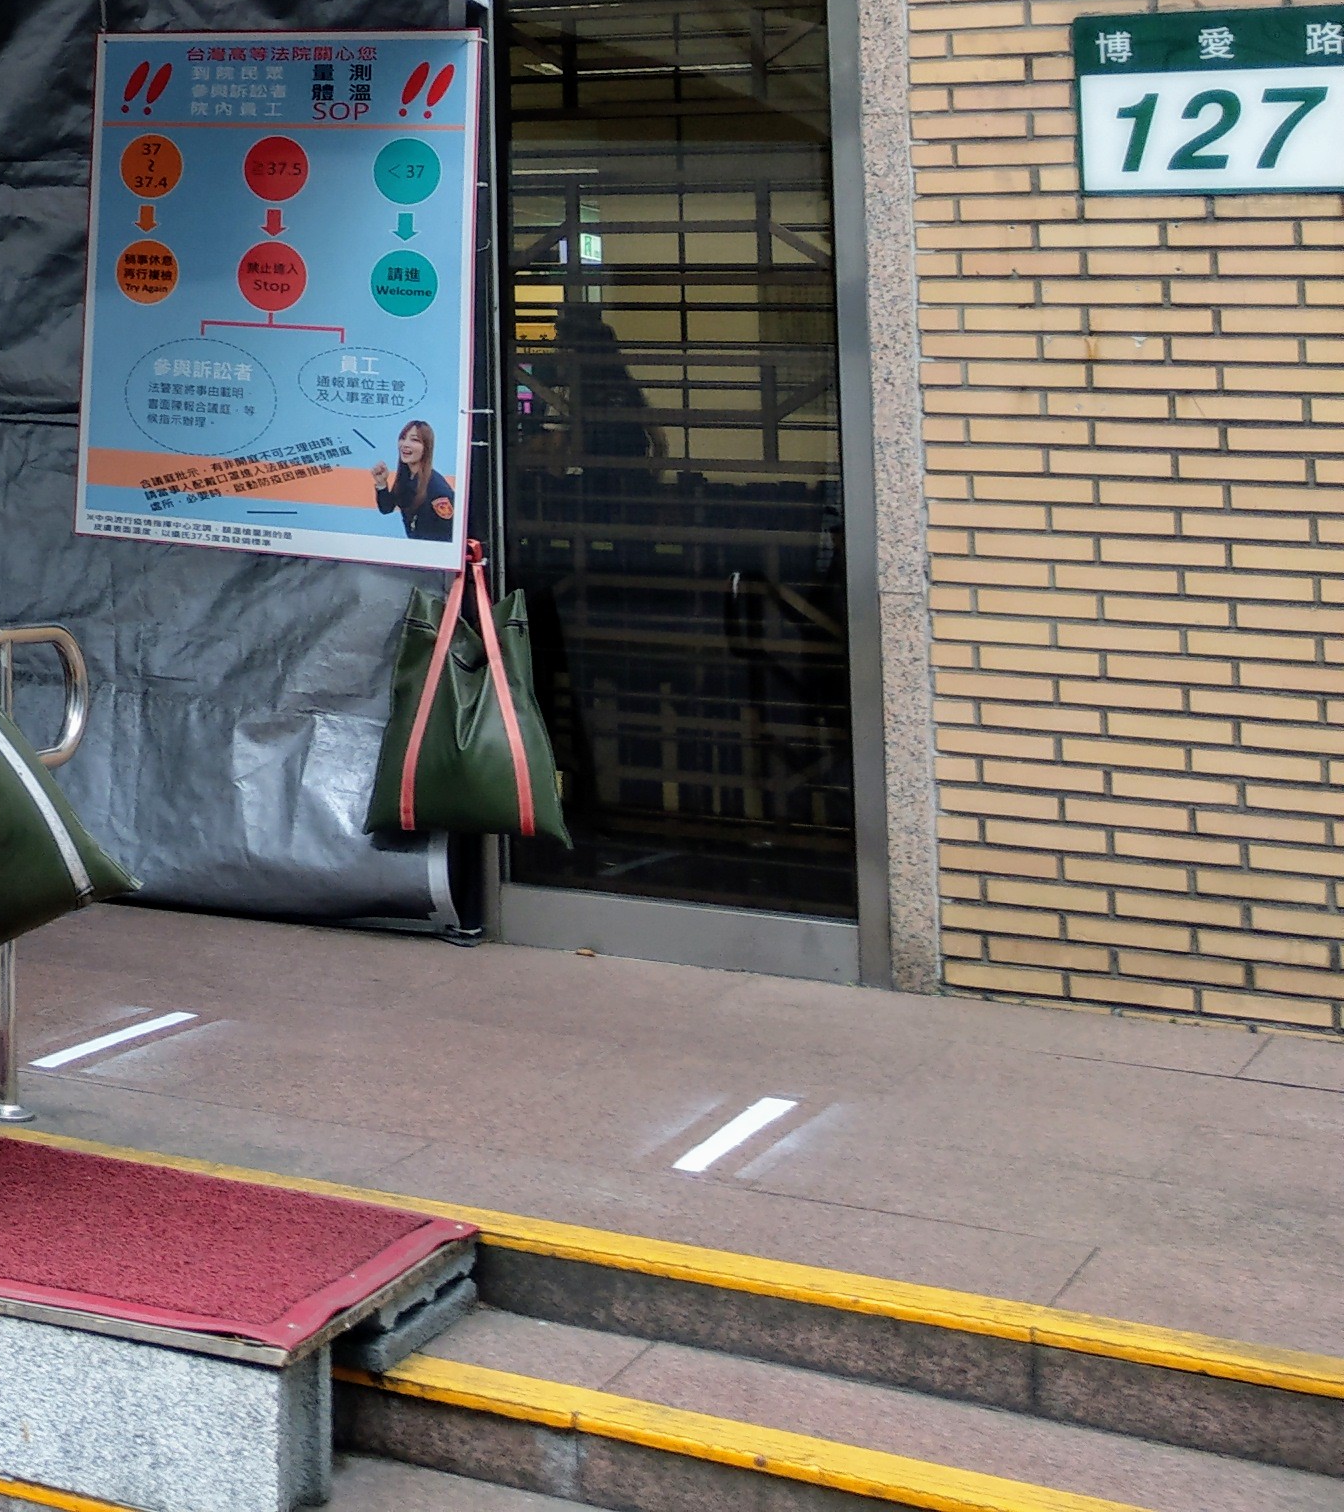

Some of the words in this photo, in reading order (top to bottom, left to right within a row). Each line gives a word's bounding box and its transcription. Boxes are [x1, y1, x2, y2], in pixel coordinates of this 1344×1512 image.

[1095, 22, 1344, 65] 博愛路
[186, 46, 378, 62] 台灣高等法院關心您
[312, 84, 372, 102] 體溫
[312, 102, 370, 120] SOP
[1115, 86, 1329, 173] 127
[141, 143, 162, 156] 37
[134, 176, 168, 189] 37.4
[387, 267, 421, 283] 請進
[253, 279, 291, 294] Stop
[376, 285, 433, 297] Welcome
[339, 355, 380, 376] 員工
